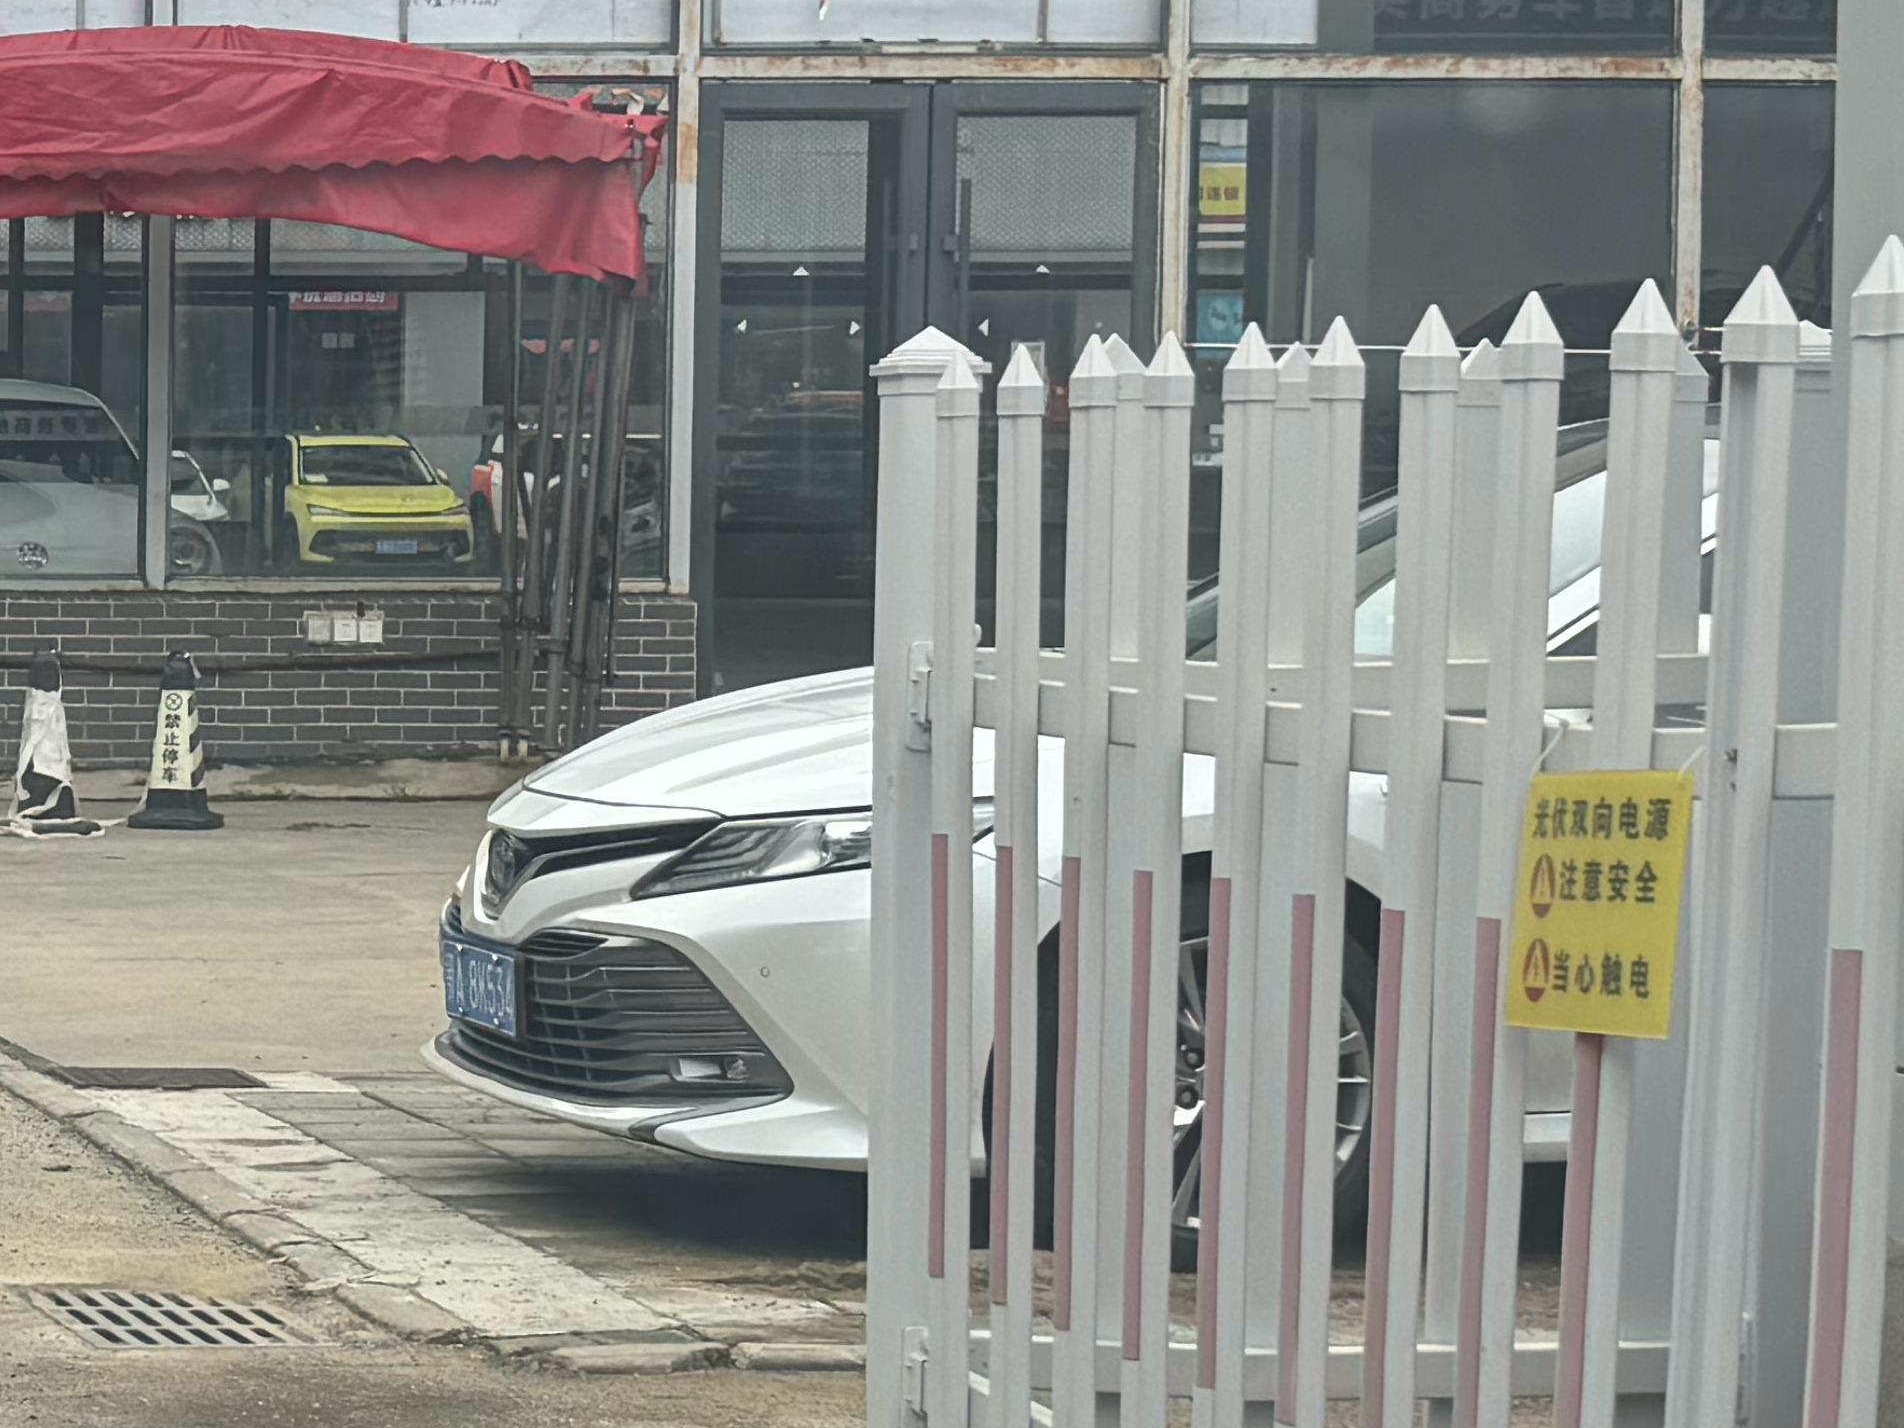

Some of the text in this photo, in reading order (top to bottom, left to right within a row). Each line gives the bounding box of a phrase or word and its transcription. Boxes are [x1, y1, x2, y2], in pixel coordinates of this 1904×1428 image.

[1558, 859, 1658, 904] 注意安全
[1550, 949, 1650, 999] 当心触电
